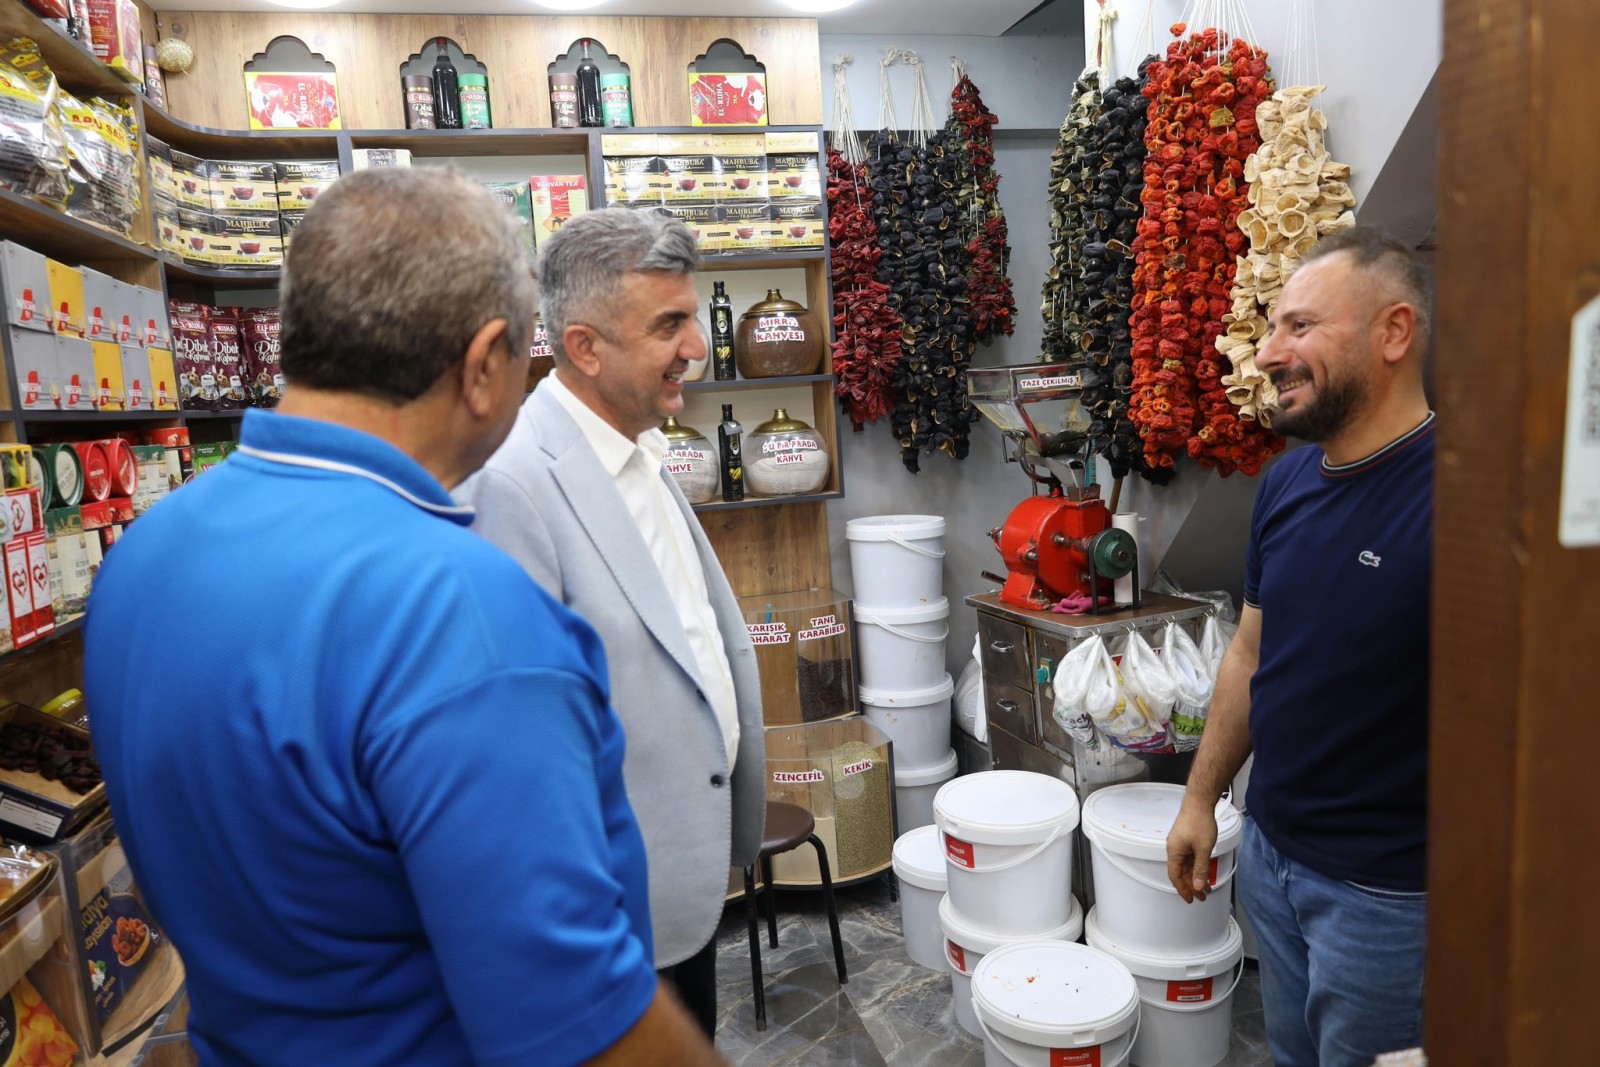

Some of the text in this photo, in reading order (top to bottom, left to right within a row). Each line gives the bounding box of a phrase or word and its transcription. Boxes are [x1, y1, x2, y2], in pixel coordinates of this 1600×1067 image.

[669, 158, 704, 166] MAHBUBA
[722, 158, 759, 166] MAHBUBA
[775, 157, 810, 165] MAHBUBA
[217, 164, 263, 174] MAHBUBA
[672, 209, 709, 217] MAHBUBA
[726, 207, 762, 215] MAHBUBA
[779, 206, 815, 214] MAHBUBA
[225, 219, 270, 229] MAHBUBA
[256, 323, 281, 332] EL-RU
[254, 338, 281, 353] Dib
[1021, 379, 1041, 387] TAZE
[675, 450, 705, 460] ARADA
[776, 453, 804, 464] KAHVE
[666, 463, 692, 473] AHVE
[811, 615, 835, 627] TANE
[799, 624, 845, 640] KARABİBER
[750, 634, 790, 644] AHARAT
[844, 760, 872, 775] KEKİK
[774, 770, 823, 782] ZENCEFİL
